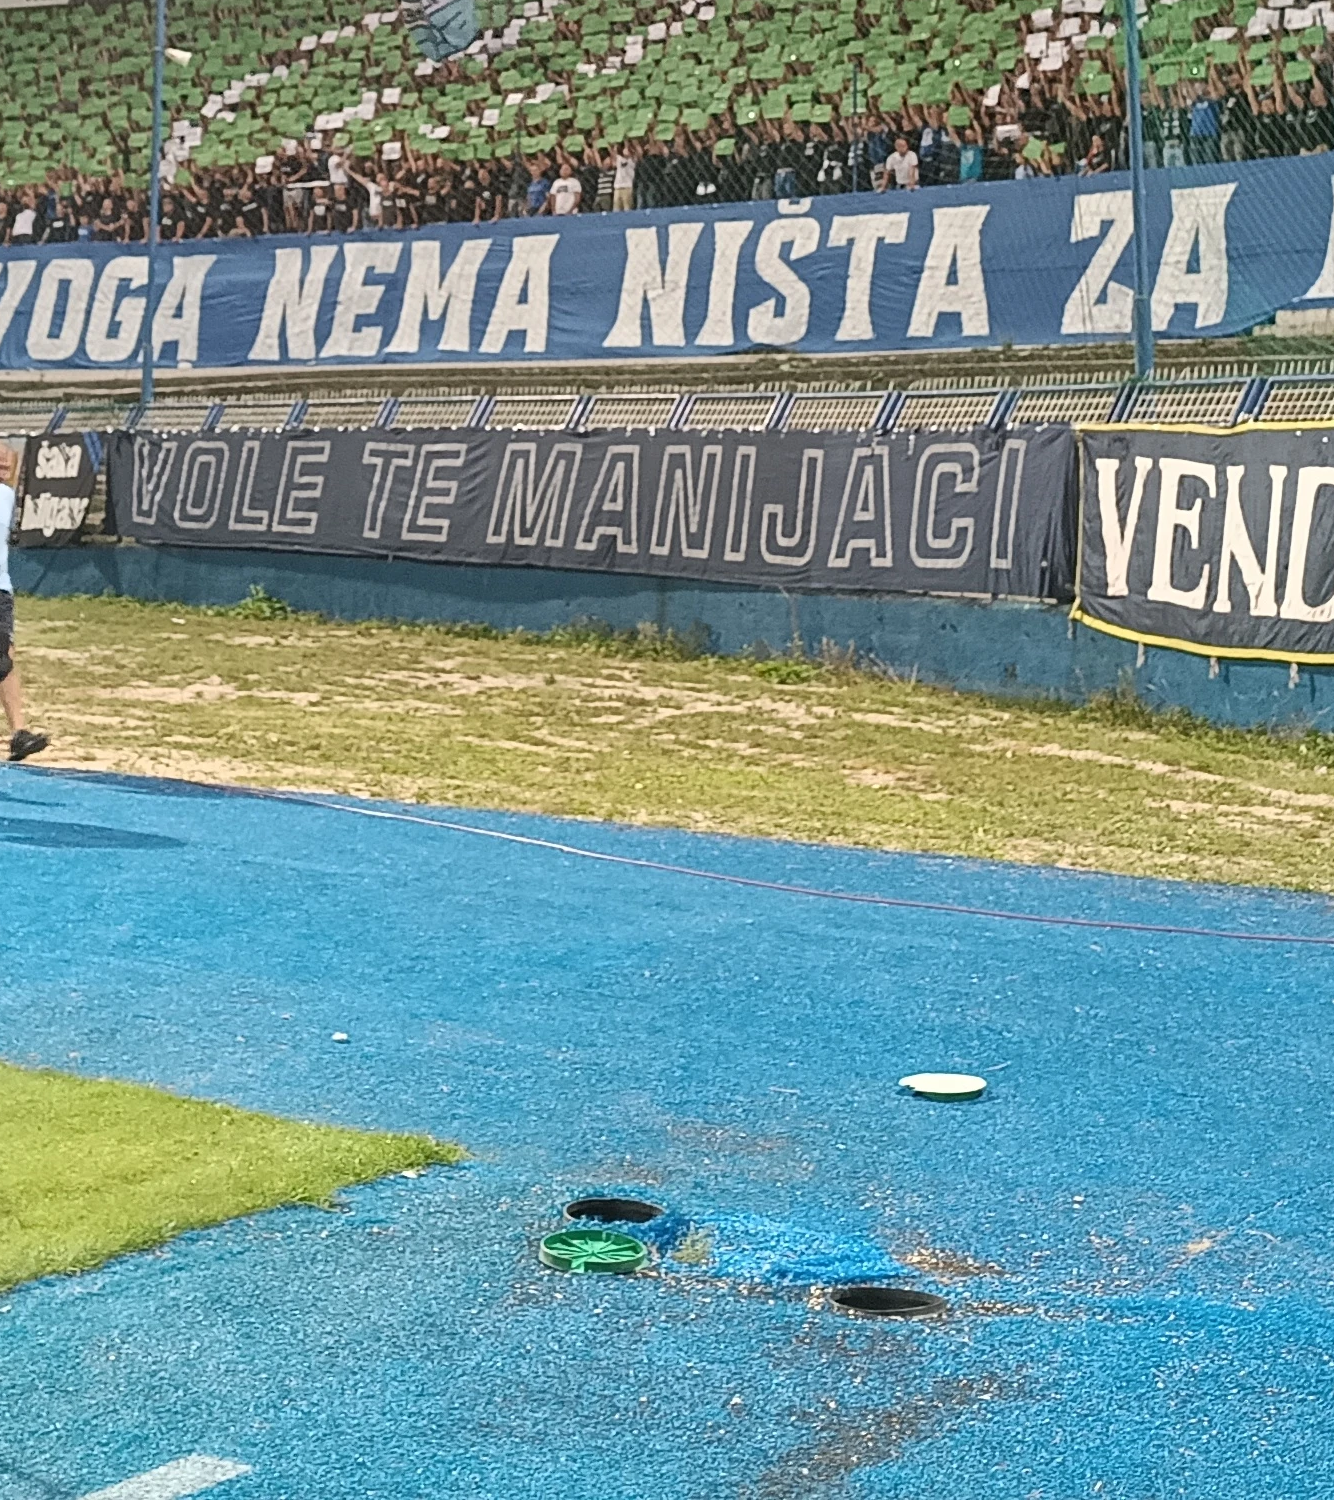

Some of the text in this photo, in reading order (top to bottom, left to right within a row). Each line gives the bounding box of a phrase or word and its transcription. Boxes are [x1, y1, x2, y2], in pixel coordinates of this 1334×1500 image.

[249, 233, 561, 360] NEMA
[602, 199, 991, 347] NIŠTA
[1059, 182, 1239, 334] ZA
[131, 440, 331, 534] VOLE
[362, 442, 468, 543] TE
[485, 438, 1027, 570] MANIJACI
